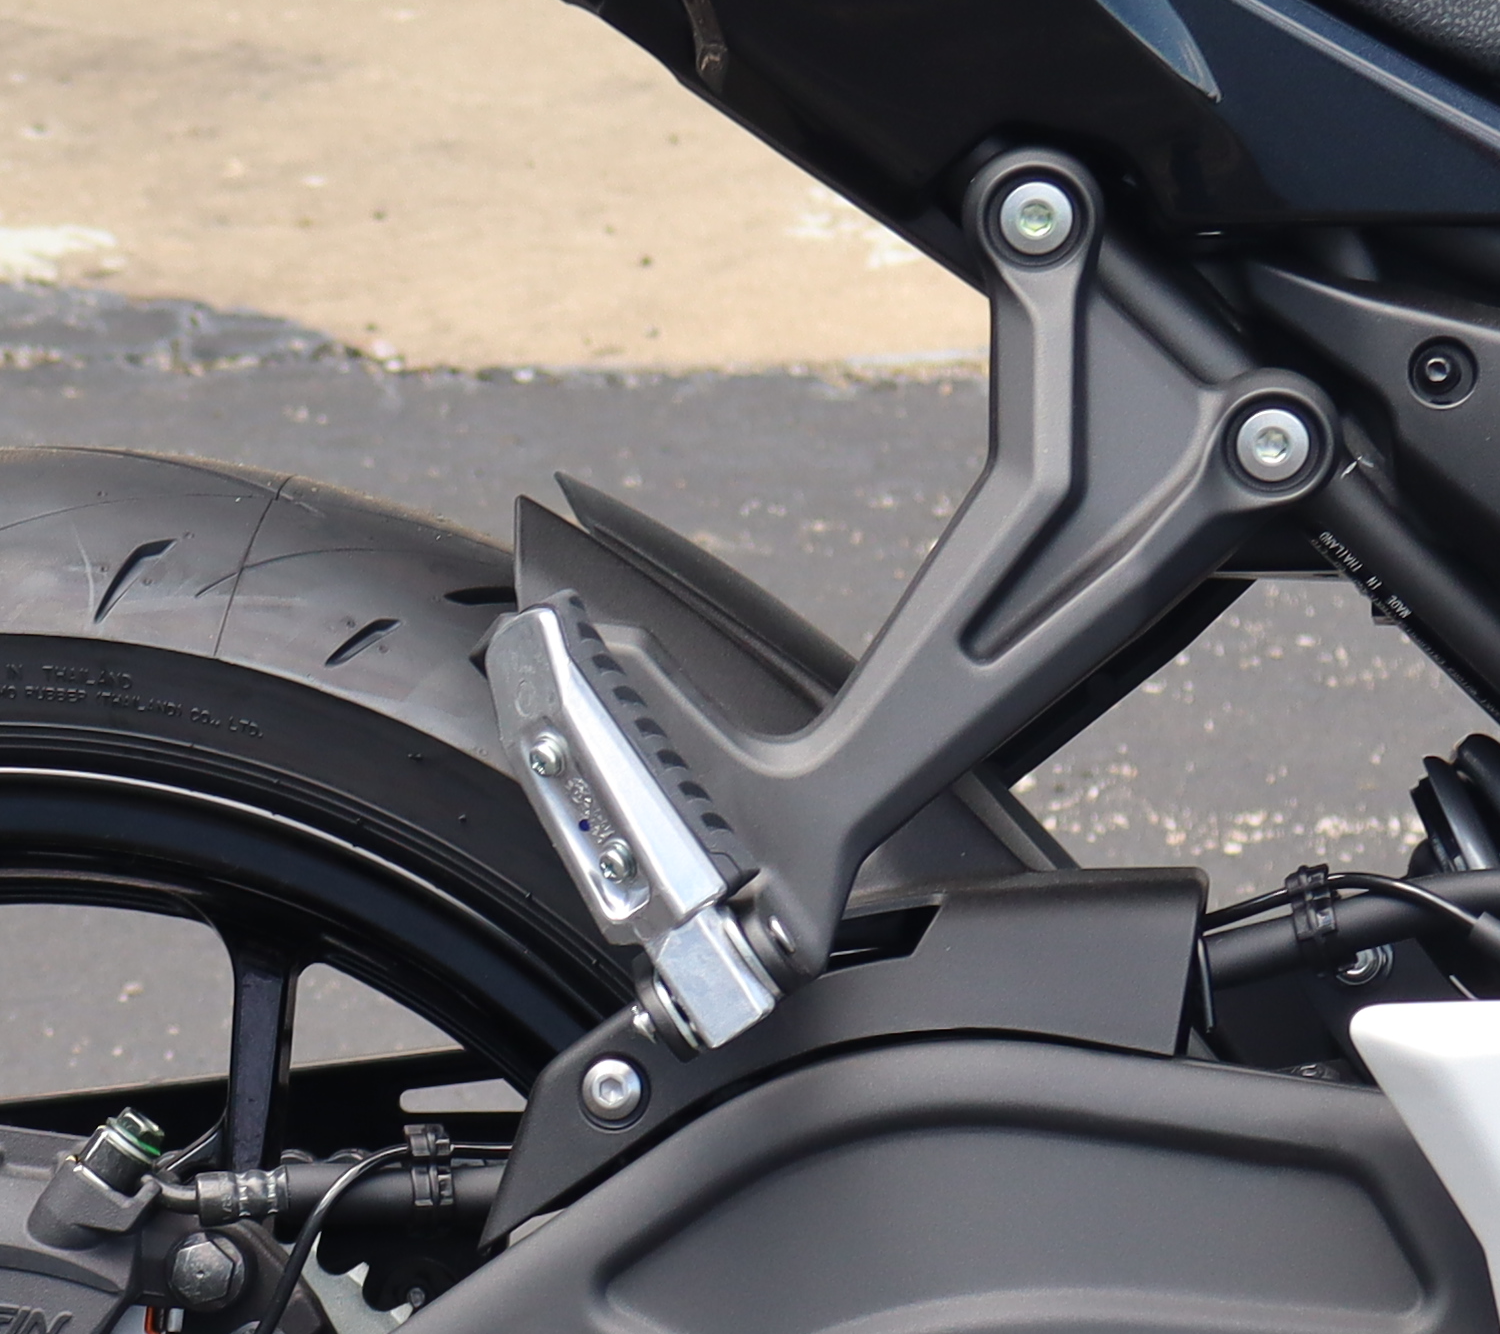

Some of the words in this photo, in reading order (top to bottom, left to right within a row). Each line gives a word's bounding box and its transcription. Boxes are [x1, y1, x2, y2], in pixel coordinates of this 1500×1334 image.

[1318, 531, 1363, 573] THAILAND
[1366, 575, 1383, 590] IN
[5, 662, 23, 681] IN
[41, 664, 135, 692] THAILAND
[25, 685, 87, 706] RUBBER
